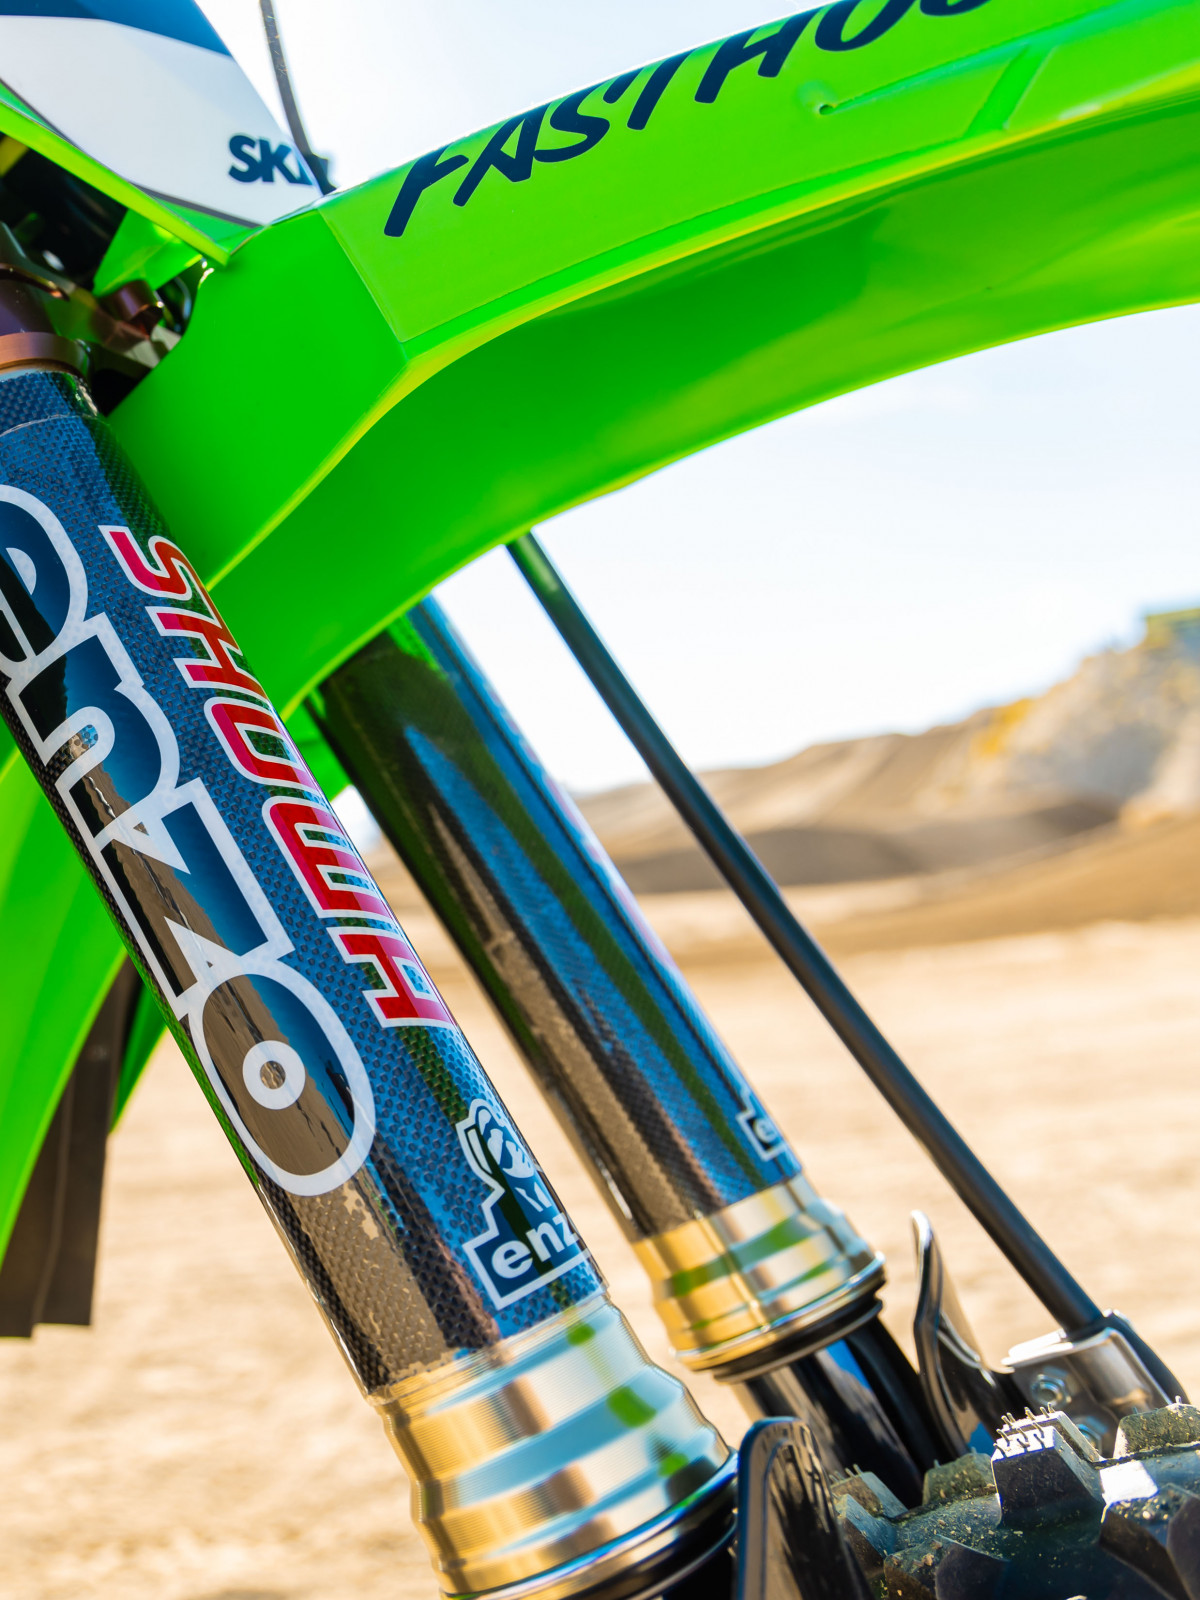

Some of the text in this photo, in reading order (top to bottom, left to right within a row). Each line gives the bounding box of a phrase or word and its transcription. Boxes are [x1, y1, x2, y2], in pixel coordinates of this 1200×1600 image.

[228, 134, 313, 186] SK
[98, 524, 460, 1029] SHOWA
[491, 1213, 579, 1279] enz
